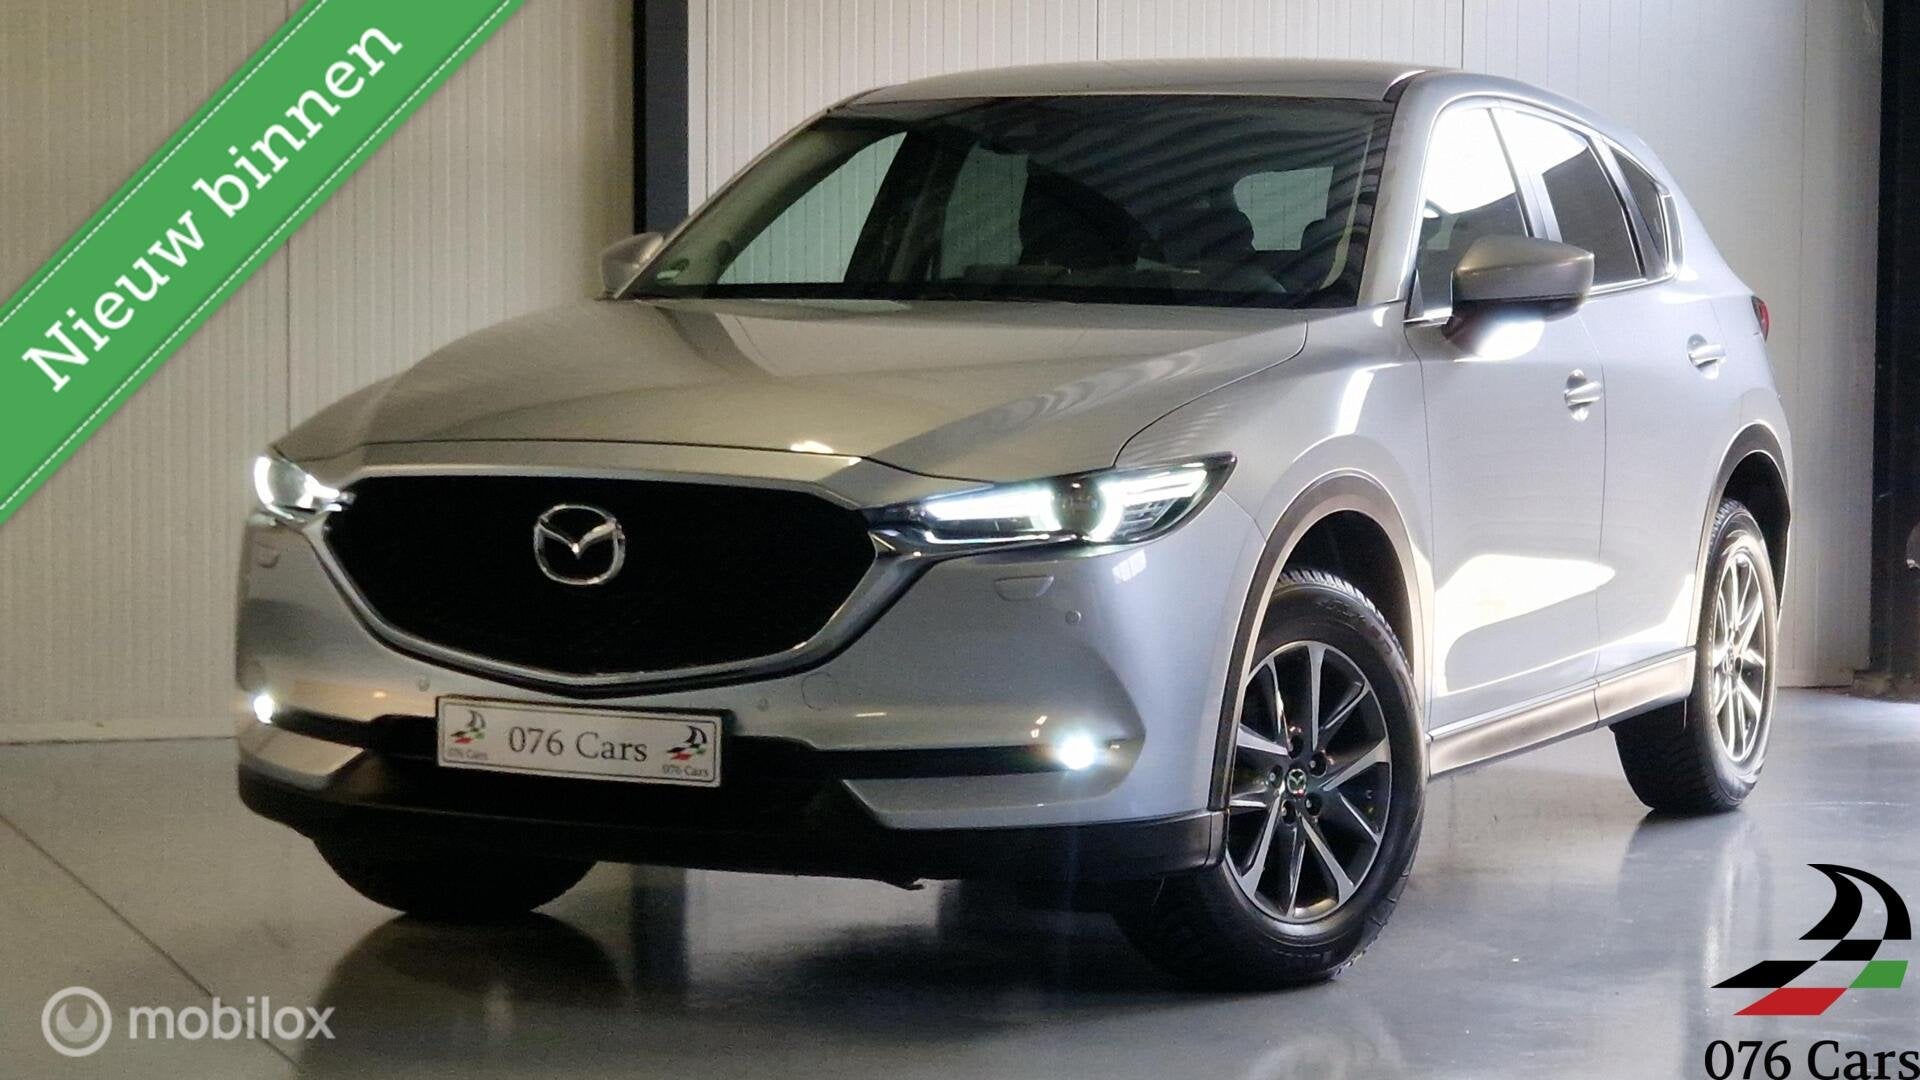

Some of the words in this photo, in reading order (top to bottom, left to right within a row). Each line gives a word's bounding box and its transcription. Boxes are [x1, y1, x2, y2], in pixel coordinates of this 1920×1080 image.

[508, 726, 564, 756] 076
[576, 731, 648, 762] Cars
[662, 764, 682, 776] 076
[684, 765, 709, 778] Cars
